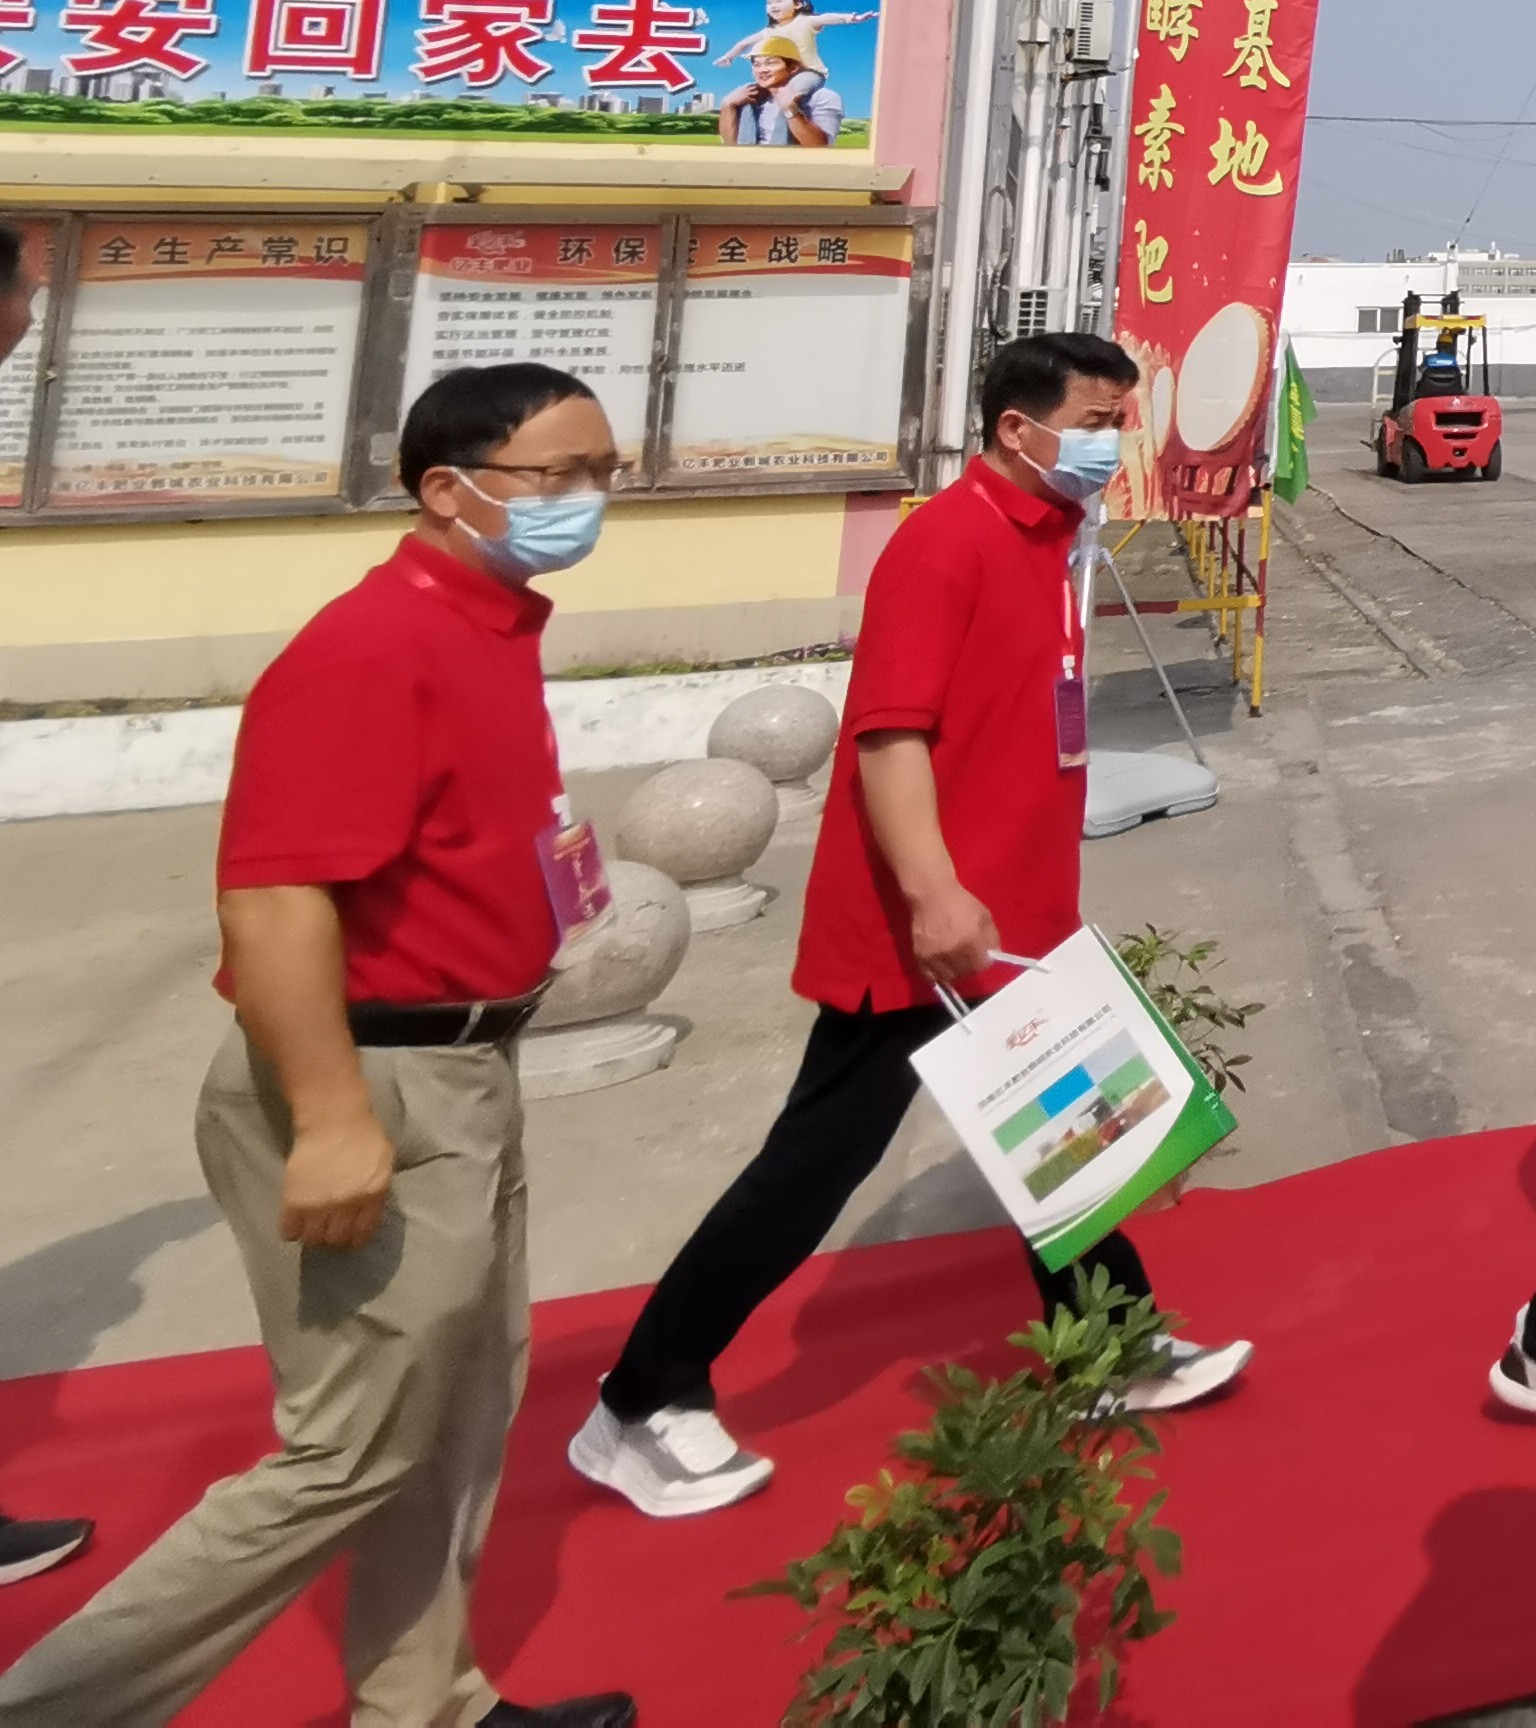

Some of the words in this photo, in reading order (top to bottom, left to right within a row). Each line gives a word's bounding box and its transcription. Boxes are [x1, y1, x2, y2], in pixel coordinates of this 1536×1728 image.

[44, 235, 351, 266] 全生产常识
